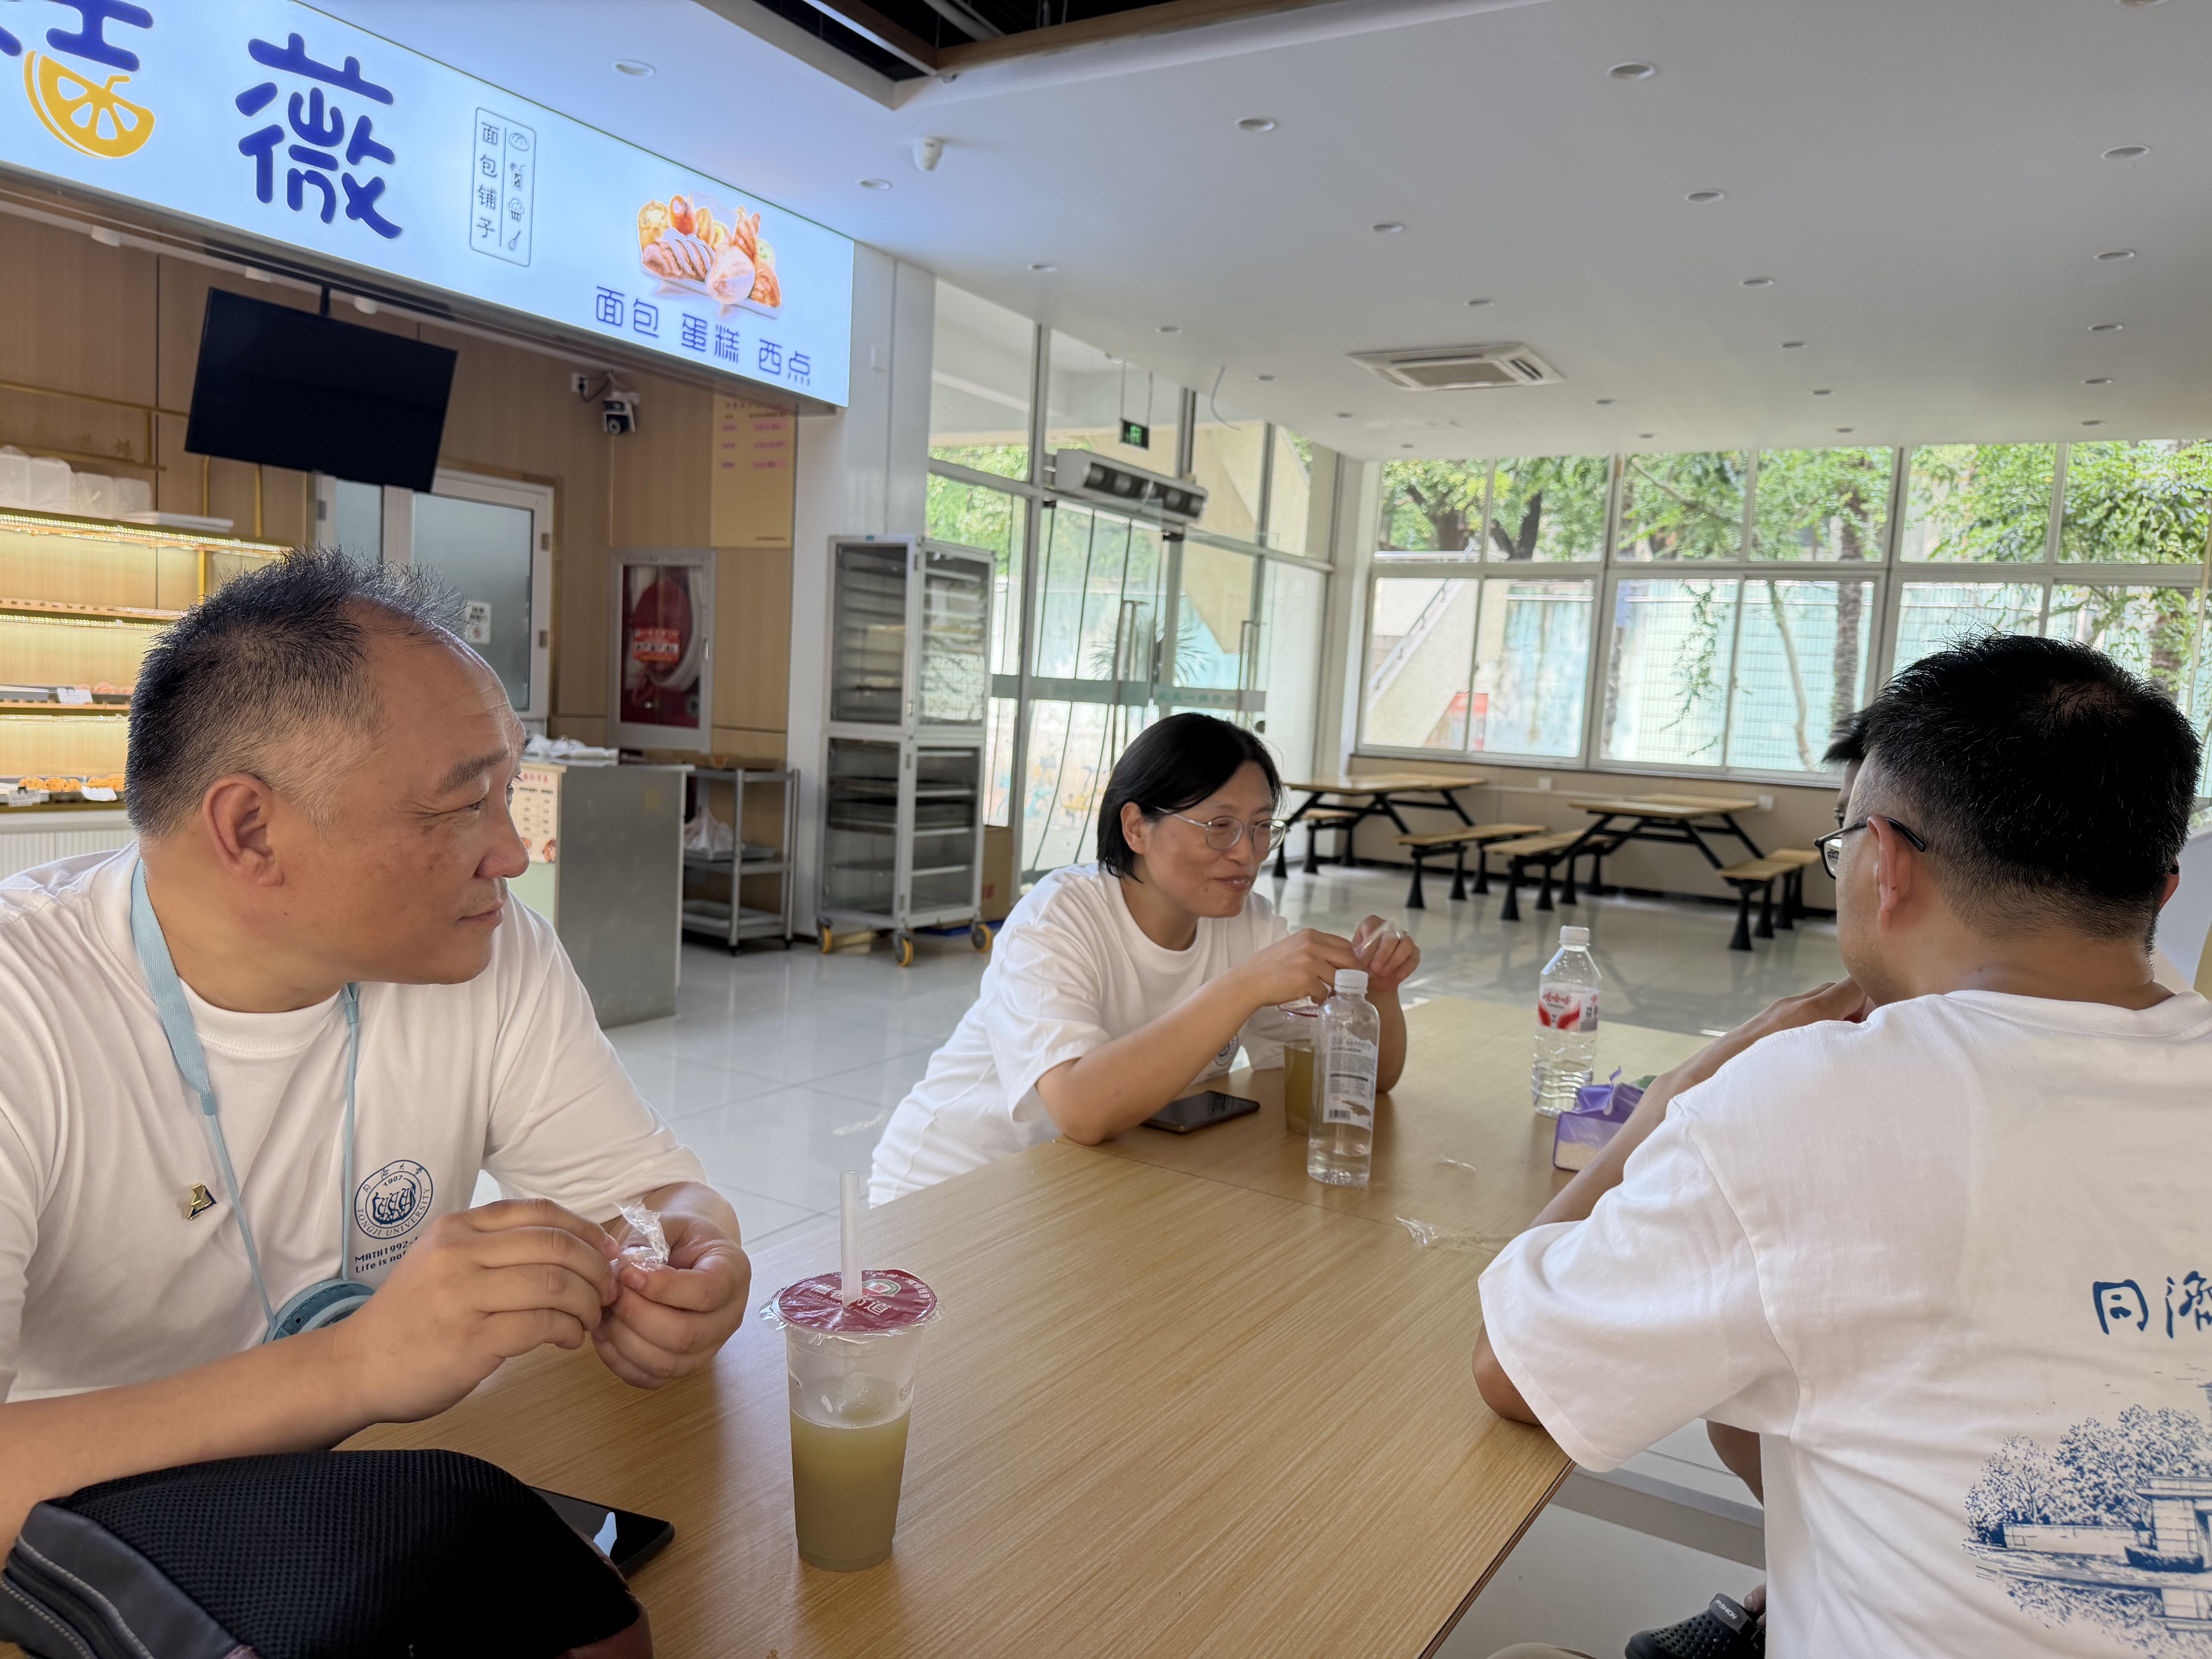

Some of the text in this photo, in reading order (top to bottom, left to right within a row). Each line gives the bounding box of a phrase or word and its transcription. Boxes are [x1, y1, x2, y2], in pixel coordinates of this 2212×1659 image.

[477, 121, 499, 238] 面包铺子
[596, 285, 811, 386] 面包 蛋糕 西点
[383, 1175, 403, 1186] 1907
[357, 1188, 430, 1236] TONGJI UNIVERSITY
[356, 1262, 376, 1273] Life
[804, 1291, 824, 1300] SWEET
